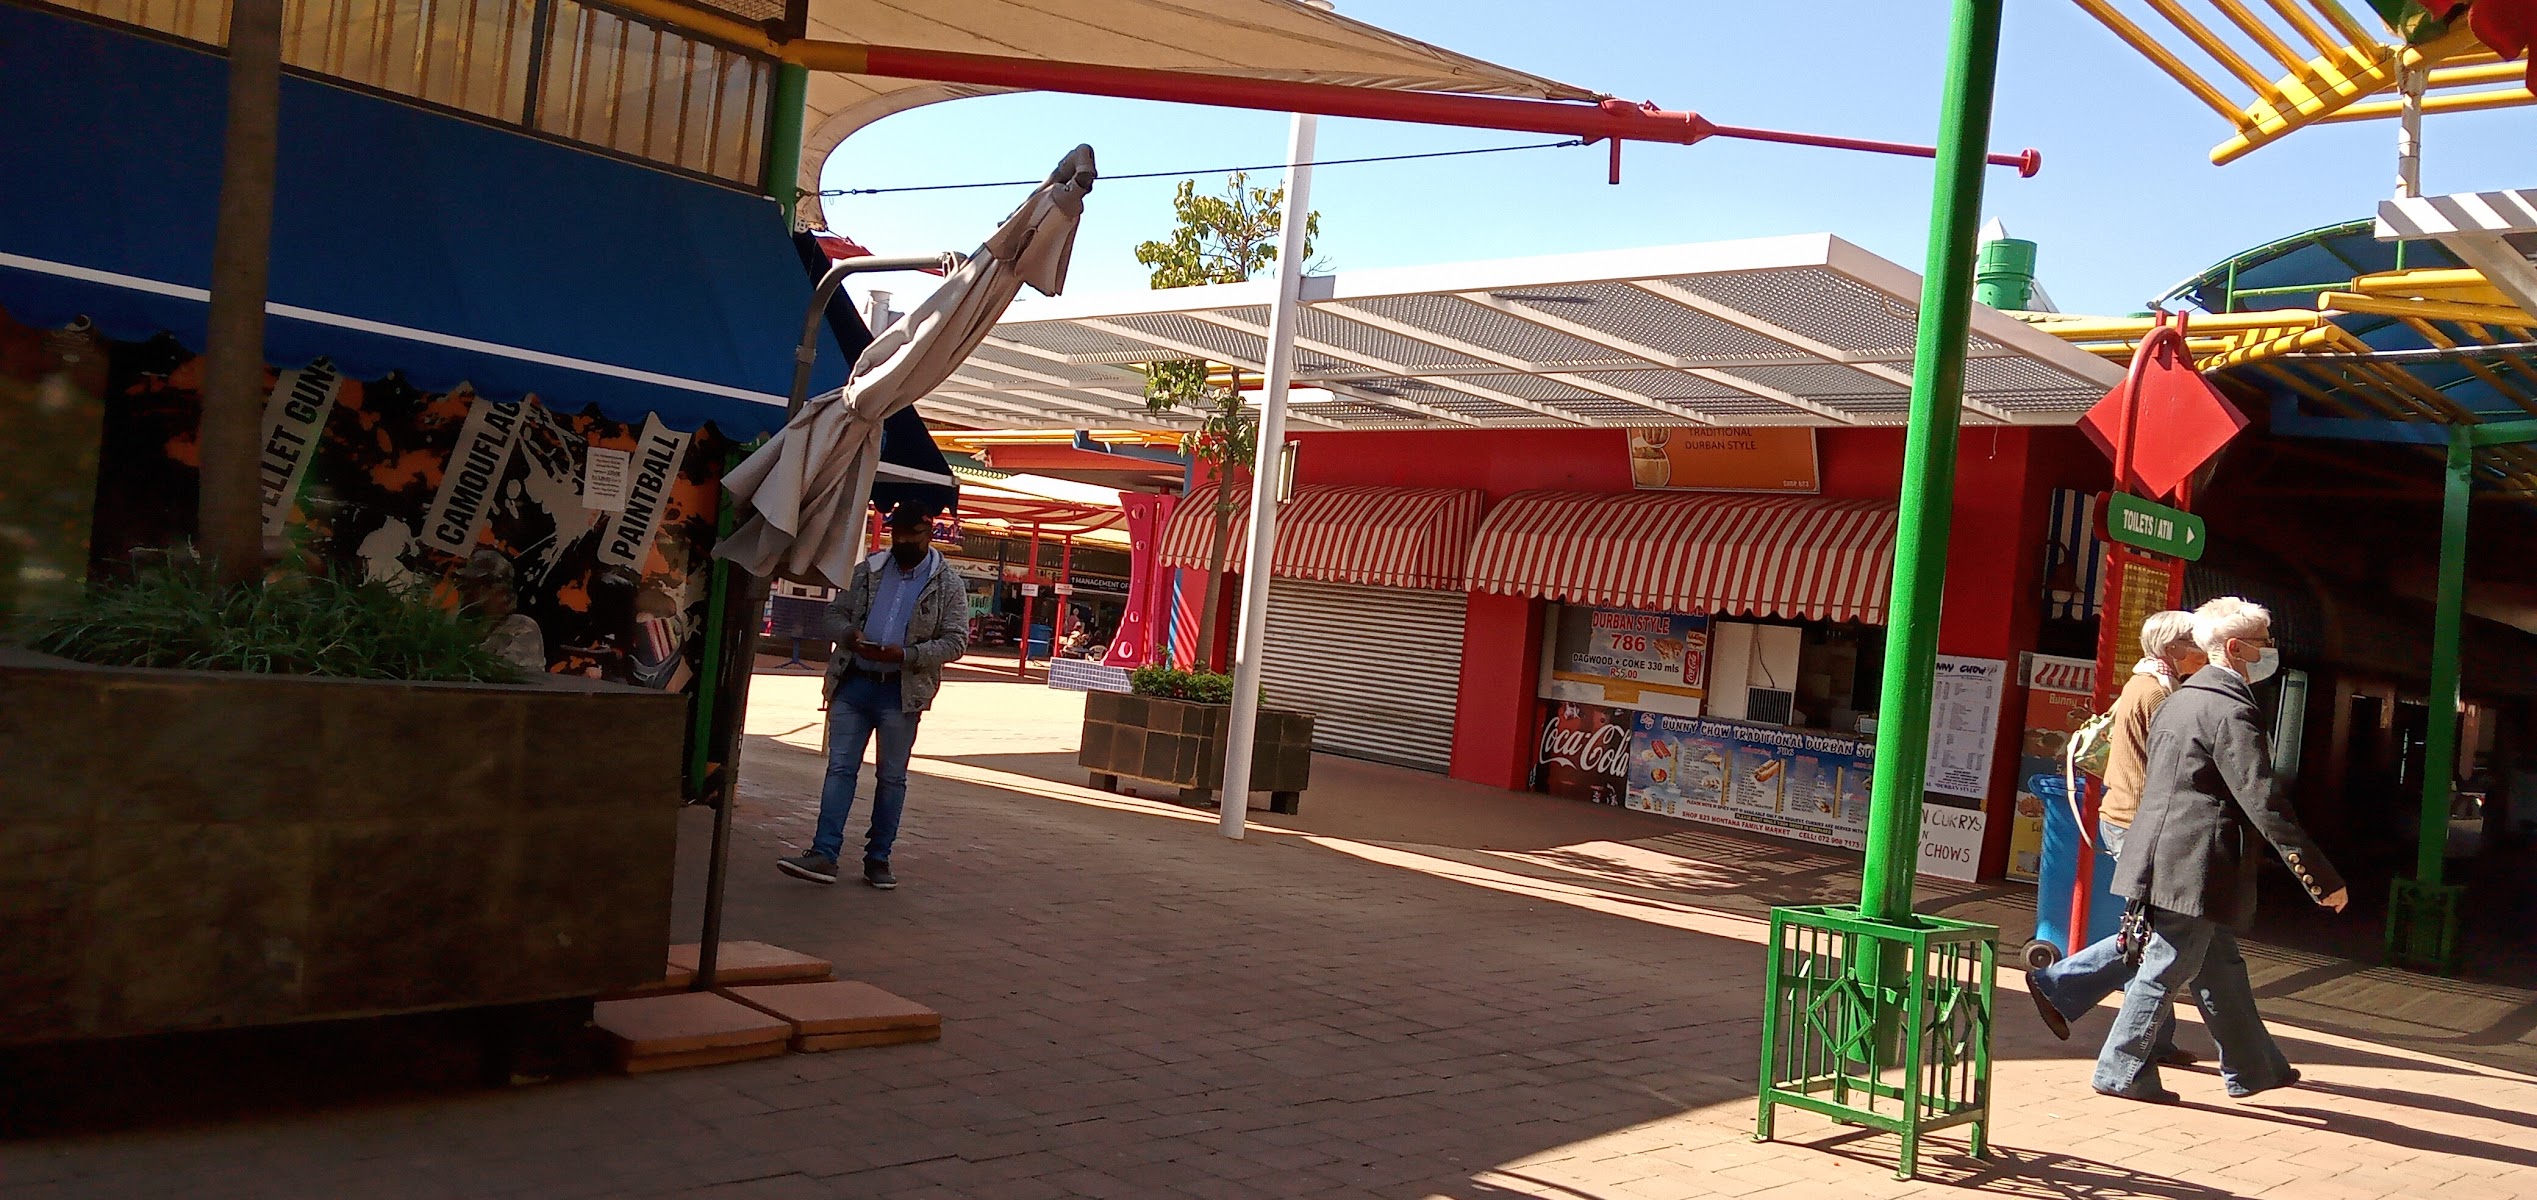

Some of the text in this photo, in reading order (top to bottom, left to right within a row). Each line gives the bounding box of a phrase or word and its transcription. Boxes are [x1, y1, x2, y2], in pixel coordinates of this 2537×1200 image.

[1689, 427, 1753, 437] TRADITIONAL
[1685, 440, 1757, 450] DURBAN STYLE
[261, 424, 305, 524] ELLET
[611, 434, 680, 561] PAINTBALL
[1075, 576, 1120, 588] MANAGEMENT
[1592, 611, 1671, 635] DURBAN STYLE
[1611, 633, 1646, 652] 786
[1573, 653, 1613, 666] DAGWOOD
[1622, 658, 1646, 670] COKE
[1647, 661, 1663, 672] 330
[1664, 663, 1680, 674] mls
[1959, 664, 1987, 676] CHOW
[2048, 692, 2078, 709] Bunny
[1661, 716, 1699, 734] BUNNY
[1700, 720, 1732, 739] CHOW
[1733, 726, 1803, 749] TRADITIONAL
[1805, 735, 1855, 756] DURBAN
[1682, 811, 1698, 819] SHOP
[1711, 816, 1740, 826] MONTANA
[1742, 821, 1763, 831] FAMILY
[1765, 826, 1790, 835] MARKET
[1932, 809, 1983, 832] CURRYS
[1924, 842, 1970, 863] CHOWS
